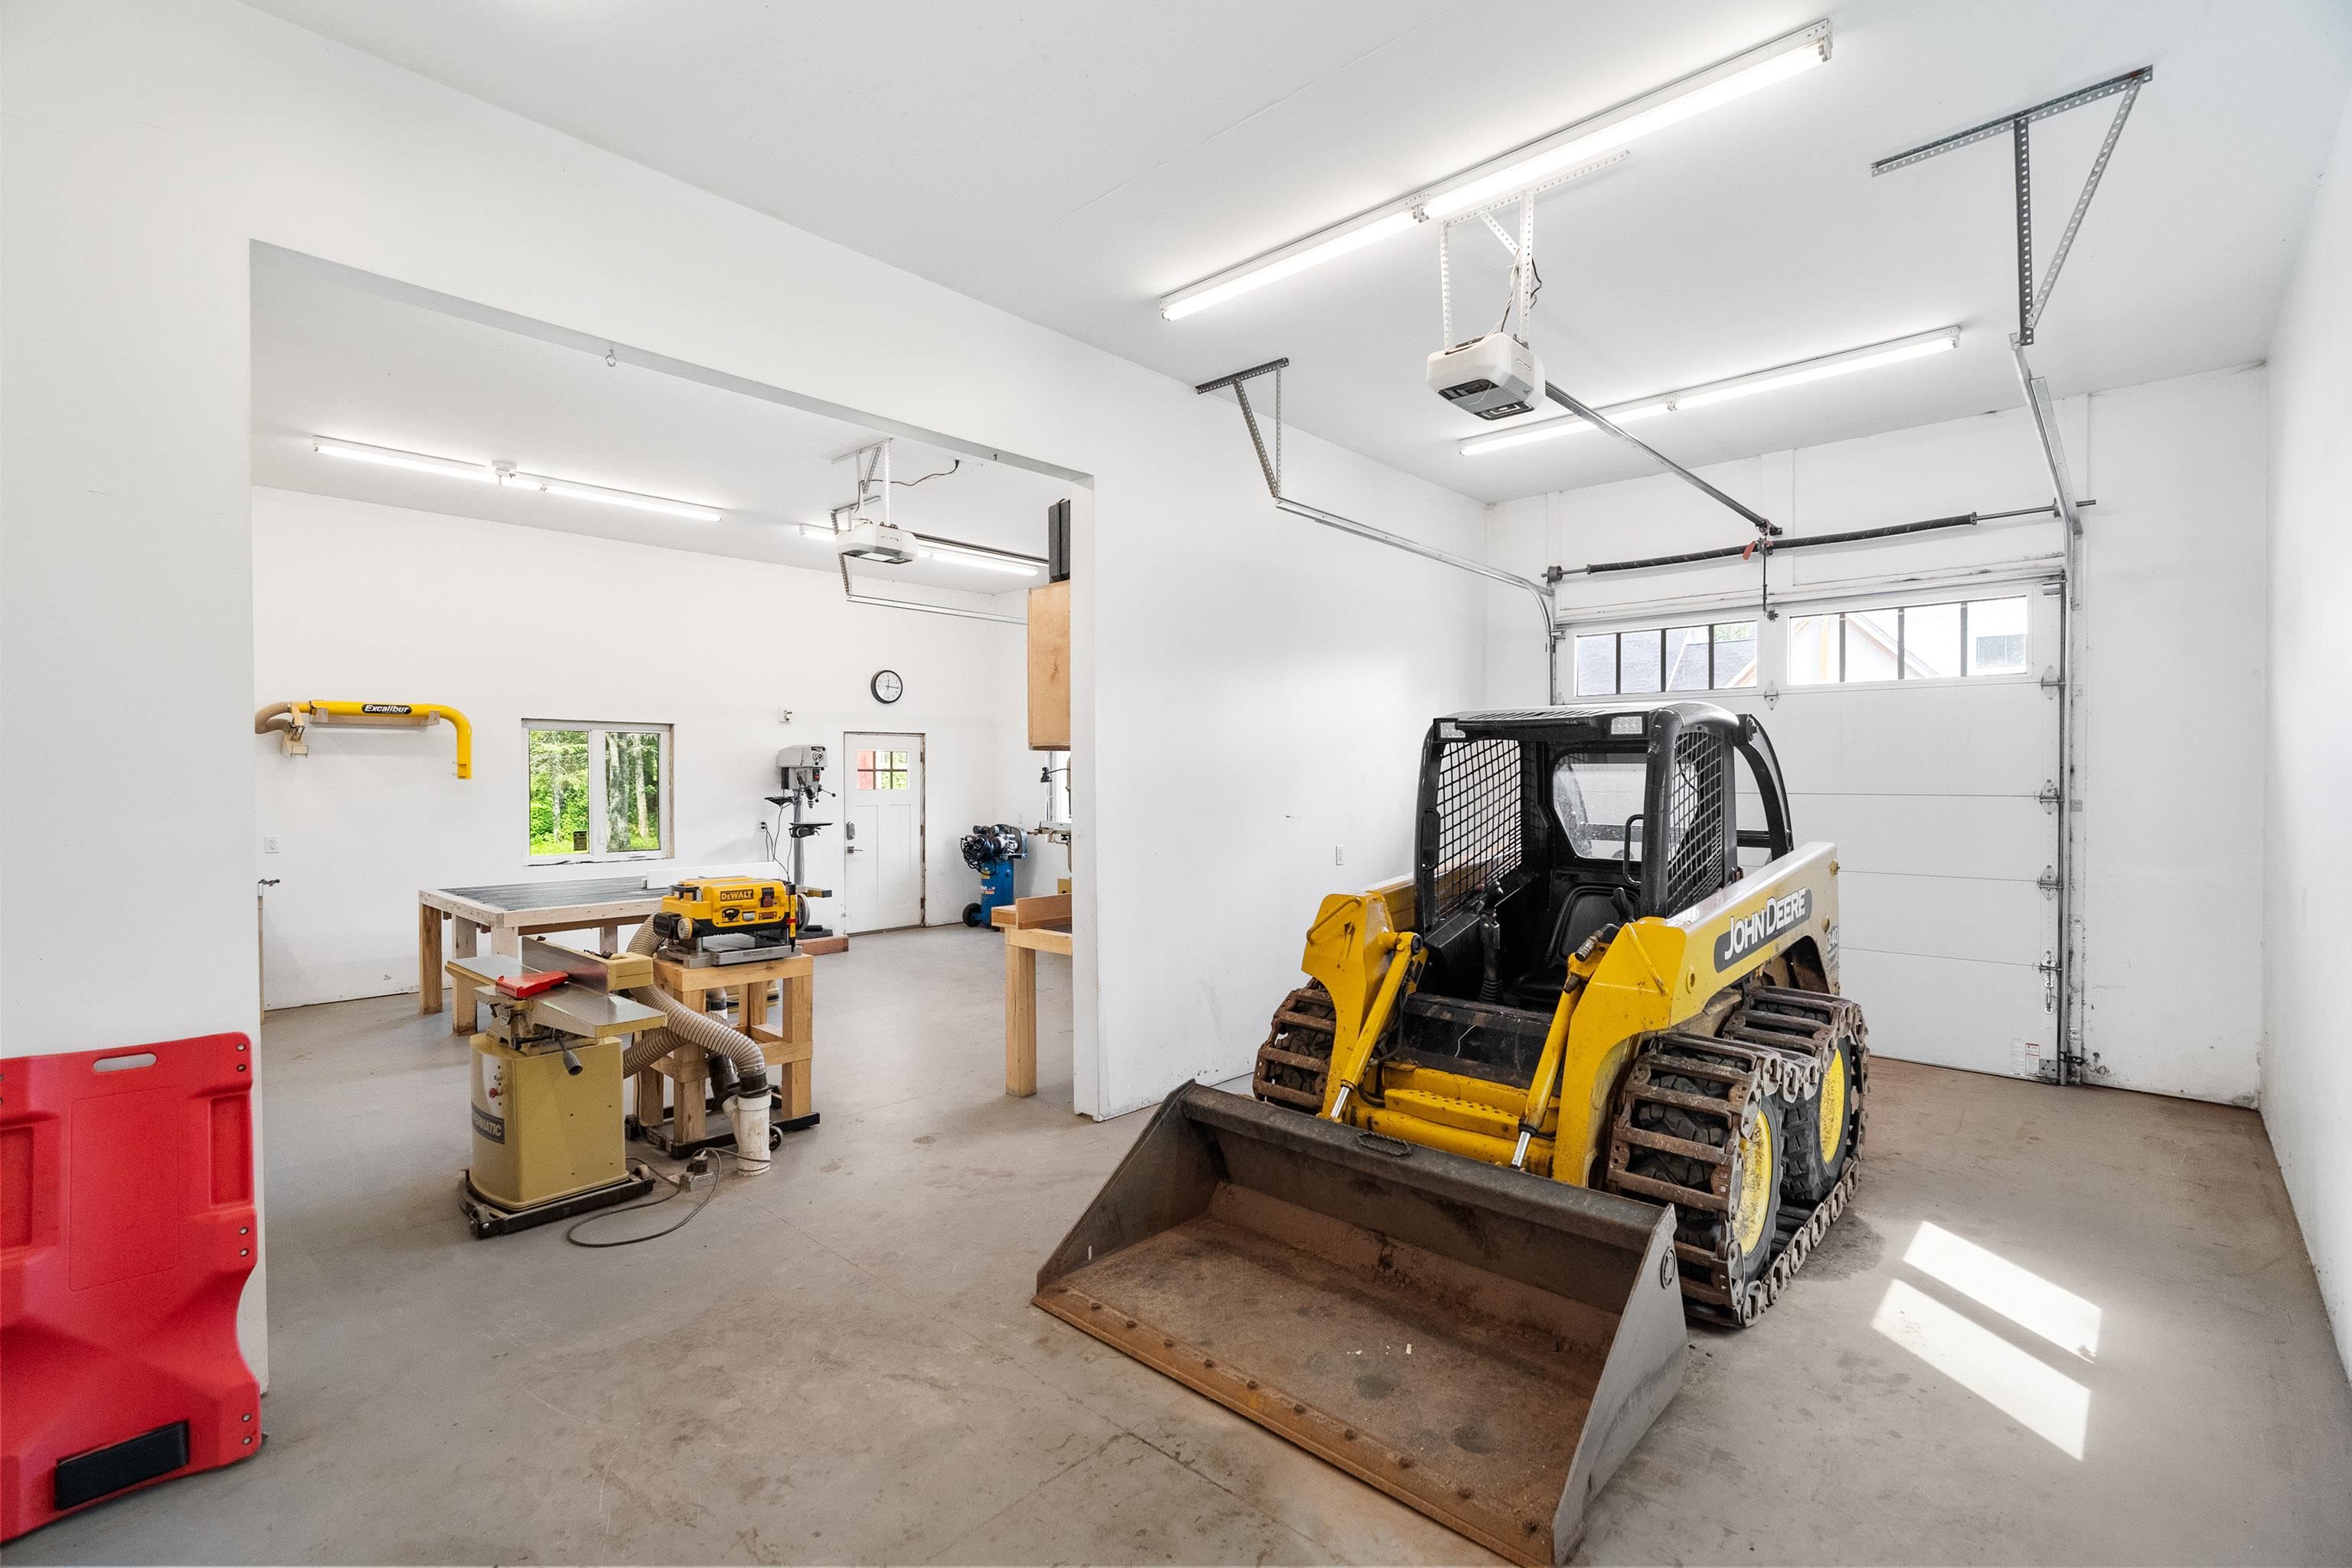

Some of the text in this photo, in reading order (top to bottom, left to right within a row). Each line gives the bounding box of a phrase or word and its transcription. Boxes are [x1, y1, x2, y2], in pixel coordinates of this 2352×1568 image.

[364, 704, 410, 713] Excalibur
[1724, 887, 1806, 960] JOHN DEERE
